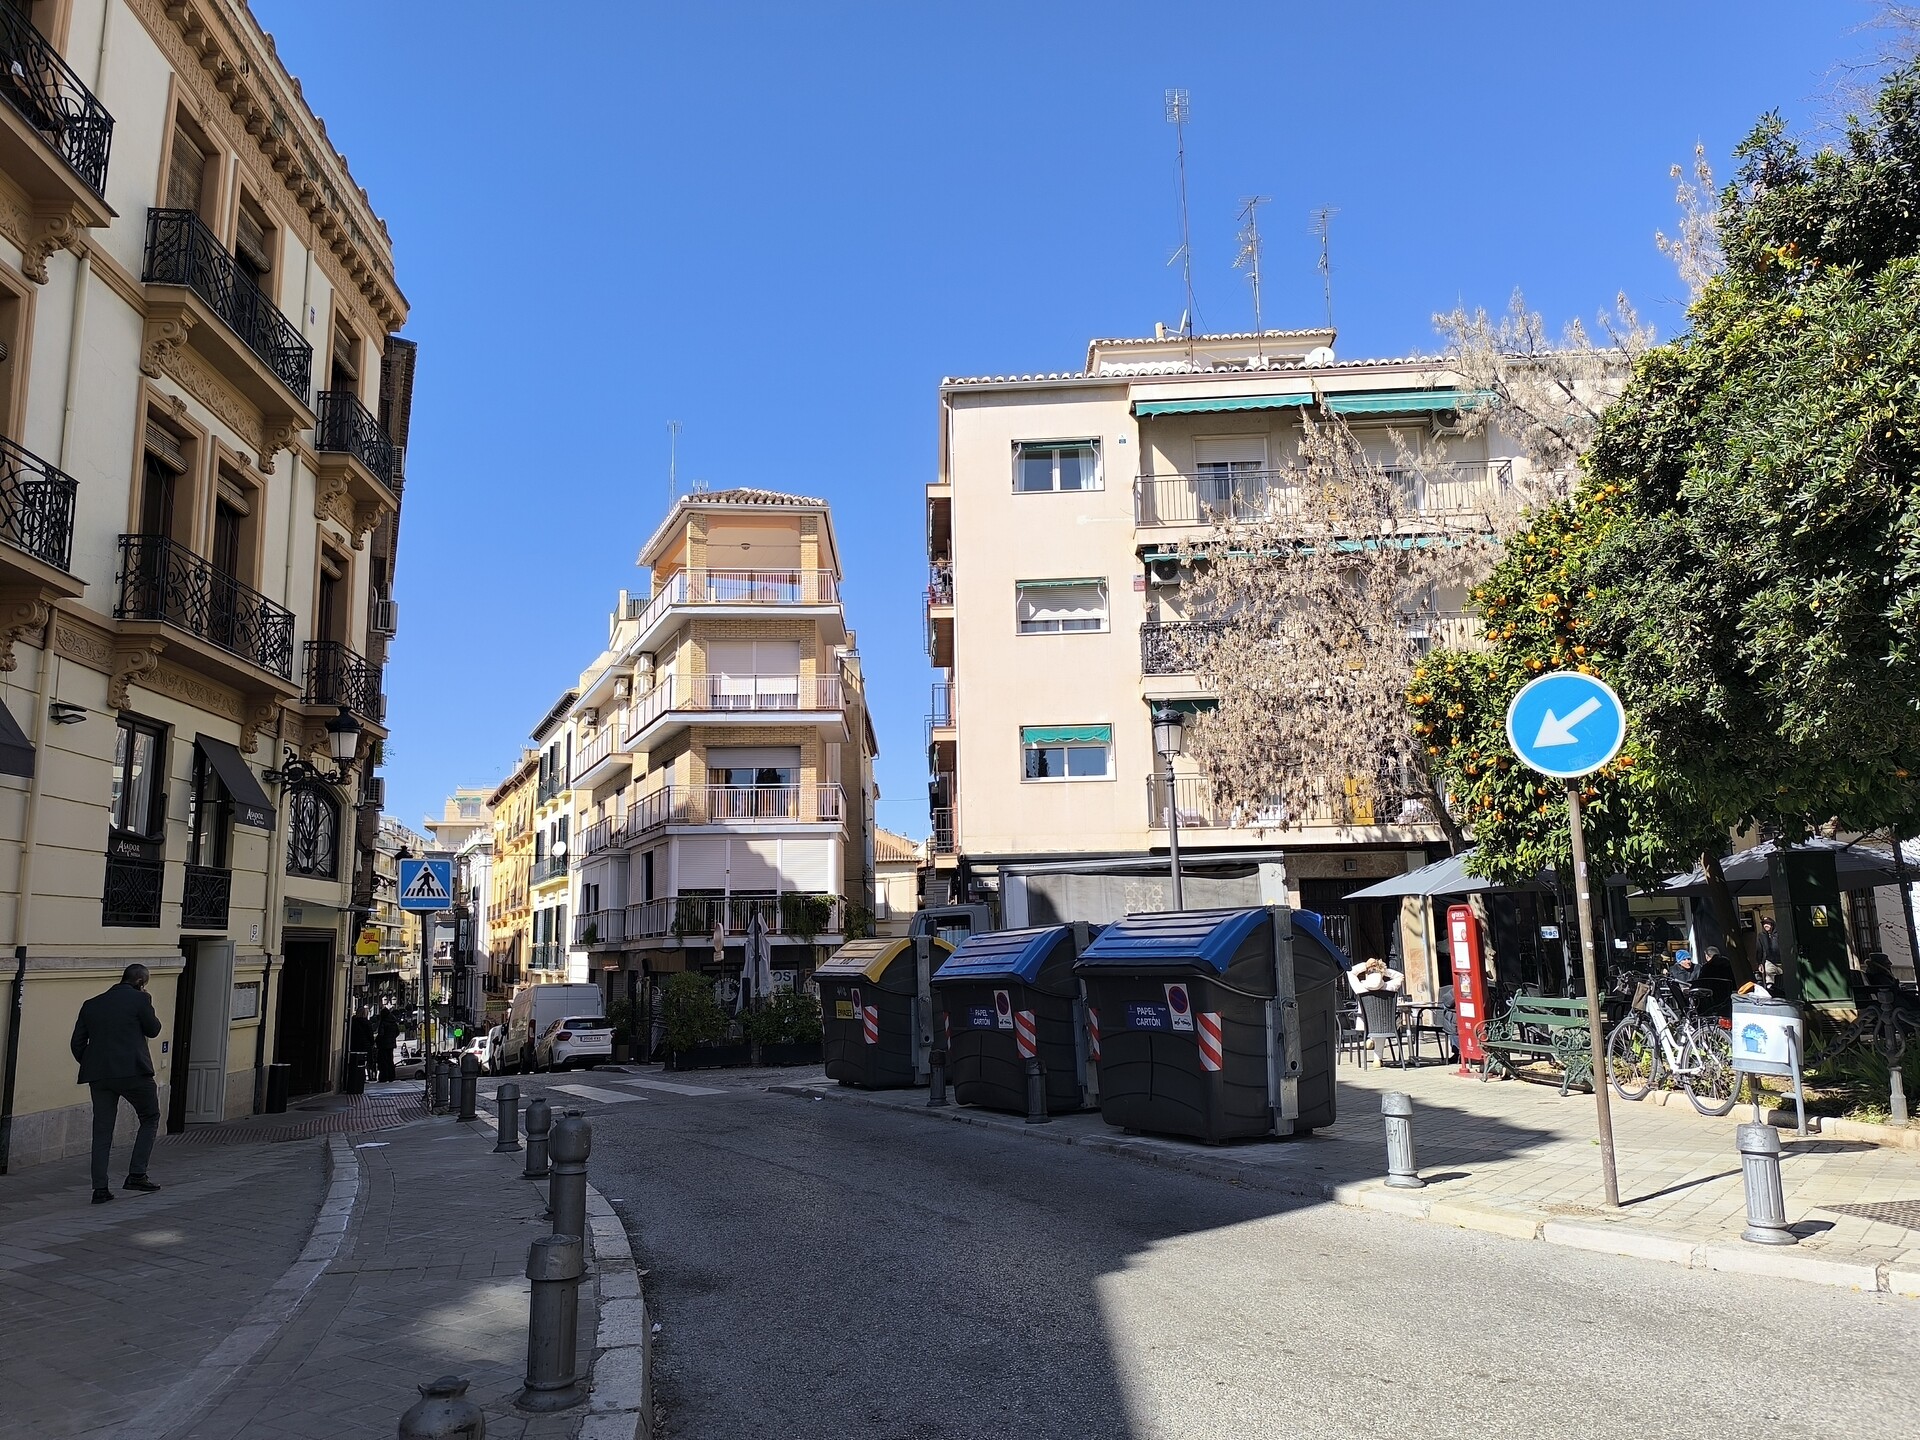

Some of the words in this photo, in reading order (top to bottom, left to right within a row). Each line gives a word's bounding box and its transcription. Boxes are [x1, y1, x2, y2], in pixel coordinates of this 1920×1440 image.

[974, 1009, 988, 1017] PAPEL
[1136, 1007, 1157, 1016] PAPEL
[1135, 1016, 1161, 1026] CARTÓN
